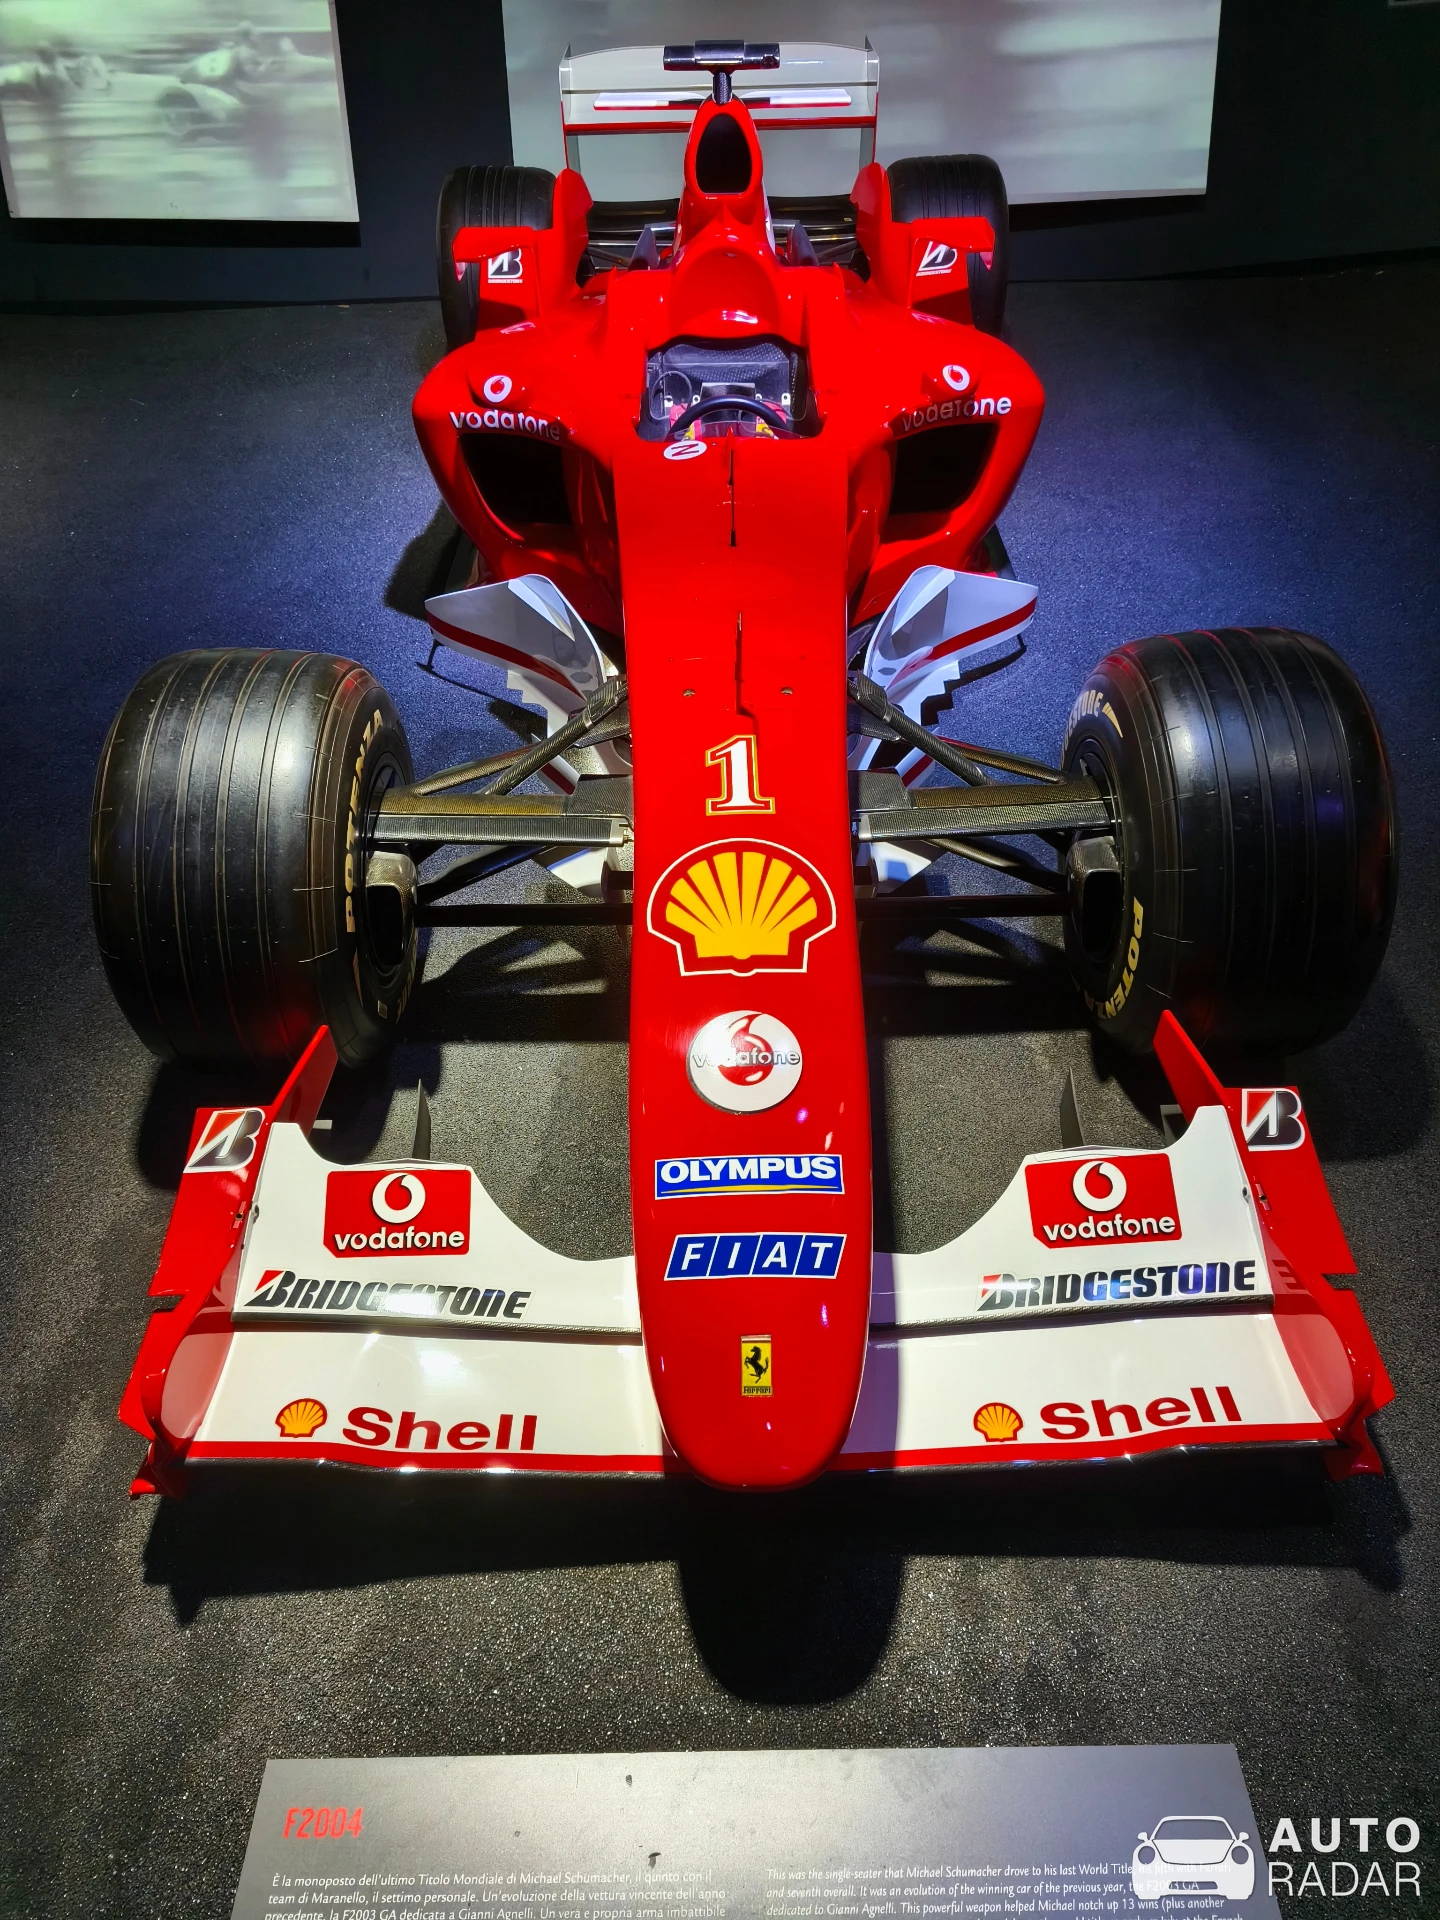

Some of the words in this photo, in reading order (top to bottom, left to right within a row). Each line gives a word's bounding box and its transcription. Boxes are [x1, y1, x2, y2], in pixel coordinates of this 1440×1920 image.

[449, 409, 560, 441] vodafone
[902, 397, 1012, 432] vodafone
[705, 734, 776, 816] 1
[660, 1156, 837, 1184] OLYMPUS
[333, 1227, 466, 1253] vodafone
[1042, 1213, 1176, 1242] vodafone
[680, 1241, 834, 1271] FIAT
[977, 1259, 1256, 1312] BRIDGESTONE
[1040, 1386, 1242, 1440] Shell
[342, 1406, 538, 1451] Shell
[283, 1806, 364, 1839] F2004
[272, 1873, 280, 1887] È
[282, 1874, 291, 1887] la
[294, 1876, 356, 1890] monoposto
[418, 1873, 450, 1886] Titolo
[453, 1872, 504, 1884] Mondiale
[507, 1872, 516, 1884] di
[520, 1872, 561, 1884] Michael
[564, 1872, 632, 1884] Schumacher,
[635, 1871, 641, 1882] il
[644, 1871, 680, 1884] quinto
[683, 1872, 702, 1882] con
[706, 1870, 712, 1882] il
[766, 1868, 786, 1880] This
[788, 1871, 806, 1880] was
[808, 1868, 823, 1880] the
[826, 1868, 882, 1882] single-seater
[884, 1866, 904, 1878] that
[906, 1866, 943, 1878] Michael
[946, 1865, 1002, 1878] Schumacher
[1004, 1865, 1030, 1876] drove
[1032, 1866, 1042, 1876] to
[1044, 1864, 1057, 1876] his
[1060, 1863, 1076, 1876] last
[1079, 1863, 1108, 1875] World
[268, 1894, 295, 1904] team
[298, 1892, 309, 1904] di
[312, 1891, 368, 1906] Maranello,
[372, 1891, 379, 1903] il
[381, 1892, 421, 1903] settimo
[424, 1890, 478, 1906] personale.
[560, 1889, 585, 1901] della
[588, 1890, 626, 1901] vettura
[628, 1890, 673, 1900] vincente
[676, 1888, 726, 1900] dell'anno
[766, 1886, 784, 1898] and
[787, 1886, 820, 1898] seventh
[823, 1884, 857, 1897] overall.
[860, 1886, 868, 1896] It
[869, 1888, 886, 1896] was
[890, 1888, 901, 1896] an
[904, 1884, 946, 1896] evolution
[948, 1883, 960, 1897] of
[960, 1884, 975, 1895] the
[978, 1883, 1014, 1898] winning
[1016, 1884, 1032, 1894] car
[1033, 1882, 1044, 1896] of
[1045, 1882, 1060, 1894] the
[1062, 1882, 1101, 1896] previous
[1103, 1884, 1126, 1896] year,
[330, 1908, 339, 1920] la
[342, 1909, 376, 1920] F2003
[380, 1909, 396, 1920] GA
[399, 1908, 446, 1920] dedicata
[448, 1912, 455, 1920] a
[458, 1908, 494, 1920] Gianni
[496, 1907, 536, 1920] Agnelli.
[540, 1908, 556, 1919] Un
[558, 1910, 580, 1919] vera
[584, 1910, 590, 1919] e
[593, 1906, 632, 1920] propria
[636, 1909, 664, 1918] arma
[666, 1906, 726, 1918] imbattibile
[766, 1904, 812, 1916] dedicated
[814, 1905, 824, 1915] to
[826, 1902, 859, 1914] Gianni
[862, 1902, 896, 1918] Agnelli.
[900, 1902, 920, 1914] This
[922, 1901, 964, 1917] powerful
[966, 1904, 1002, 1916] weapon
[1004, 1899, 1034, 1916] helped
[1038, 1898, 1076, 1912] Michael
[1078, 1898, 1104, 1910] notch
[1106, 1901, 1119, 1914] up
[1122, 1898, 1134, 1910] 13
[1138, 1899, 1158, 1909] wins
[1162, 1898, 1186, 1912] (plus
[1188, 1897, 1225, 1909] another
